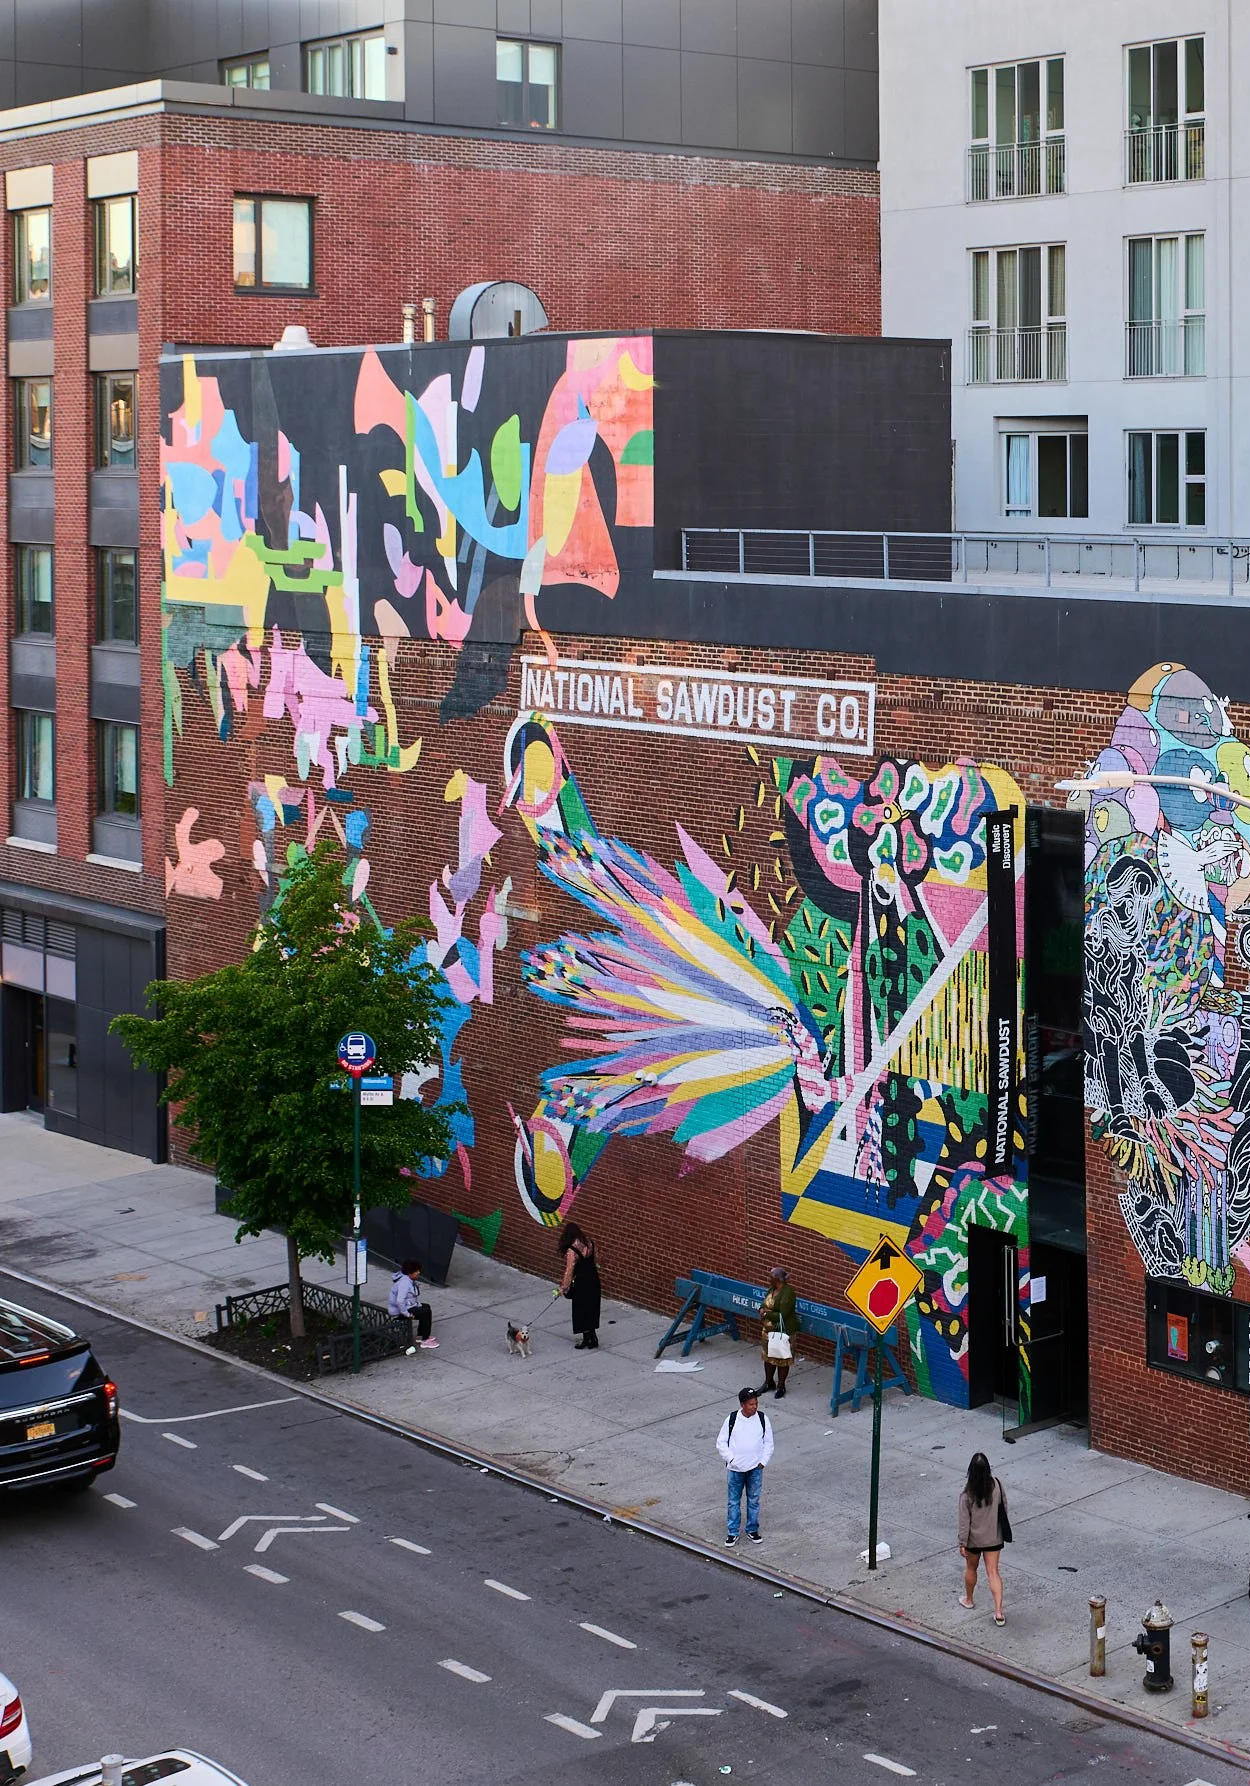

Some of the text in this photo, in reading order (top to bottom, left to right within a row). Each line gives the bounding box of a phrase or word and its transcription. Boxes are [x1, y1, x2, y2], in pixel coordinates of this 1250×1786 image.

[525, 668, 865, 740] NATIONAL SAWDUST CO.
[992, 824, 1000, 853] Music
[1002, 824, 1011, 869] Discovery
[994, 1018, 1010, 1164] NATIONAL SAWDUST
